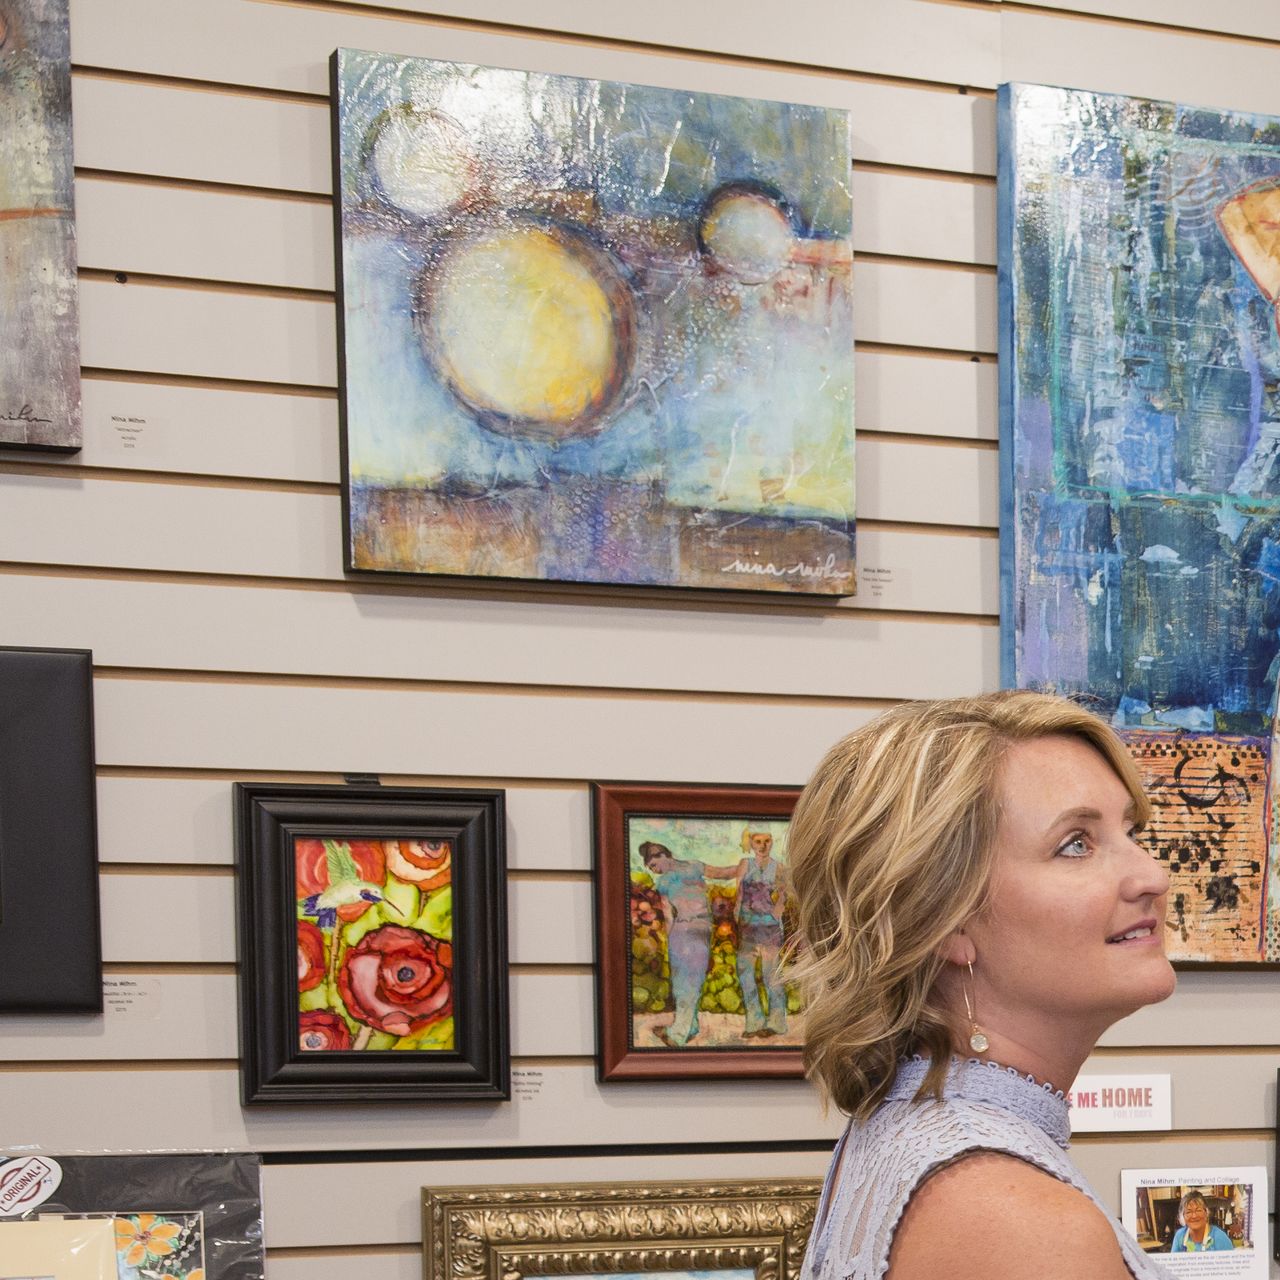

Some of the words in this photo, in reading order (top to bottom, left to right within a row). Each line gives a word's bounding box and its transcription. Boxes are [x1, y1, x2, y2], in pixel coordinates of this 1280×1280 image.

[1077, 1092, 1098, 1108] ME
[1101, 1087, 1153, 1108] HOME
[3, 1169, 41, 1202] ORIGINAL
[1178, 1177, 1203, 1185] Painting
[1216, 1176, 1240, 1184] Collage
